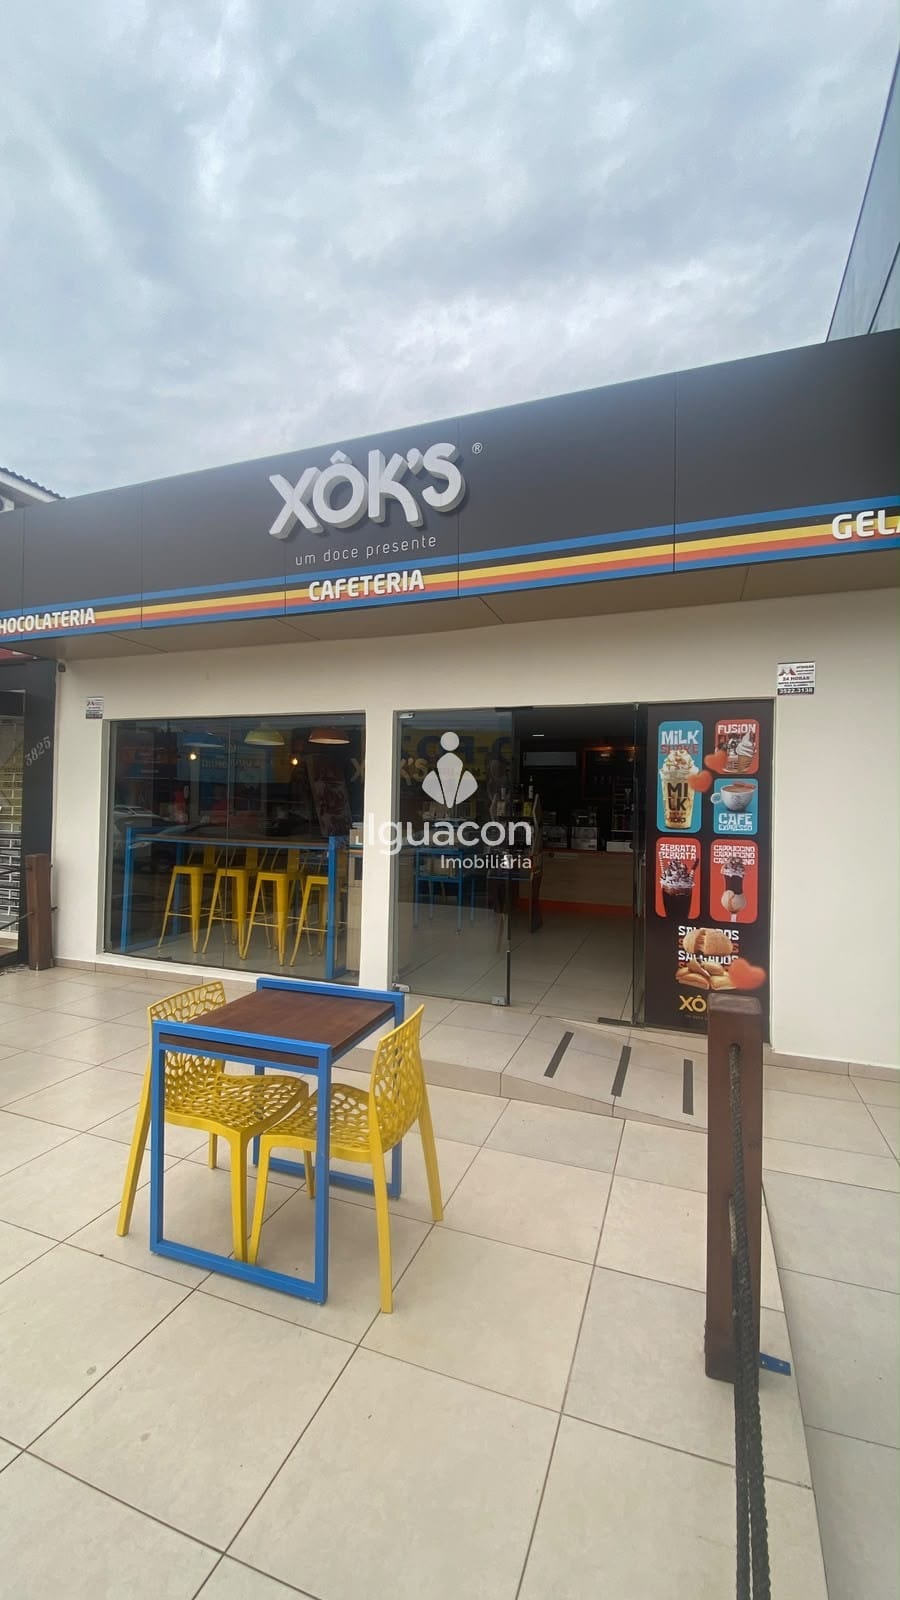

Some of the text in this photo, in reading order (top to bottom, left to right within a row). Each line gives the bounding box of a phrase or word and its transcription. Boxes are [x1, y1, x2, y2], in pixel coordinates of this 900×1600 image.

[269, 443, 465, 539] XÔK'S
[295, 535, 437, 566] um doce presente
[308, 569, 425, 601] CAFETERIA
